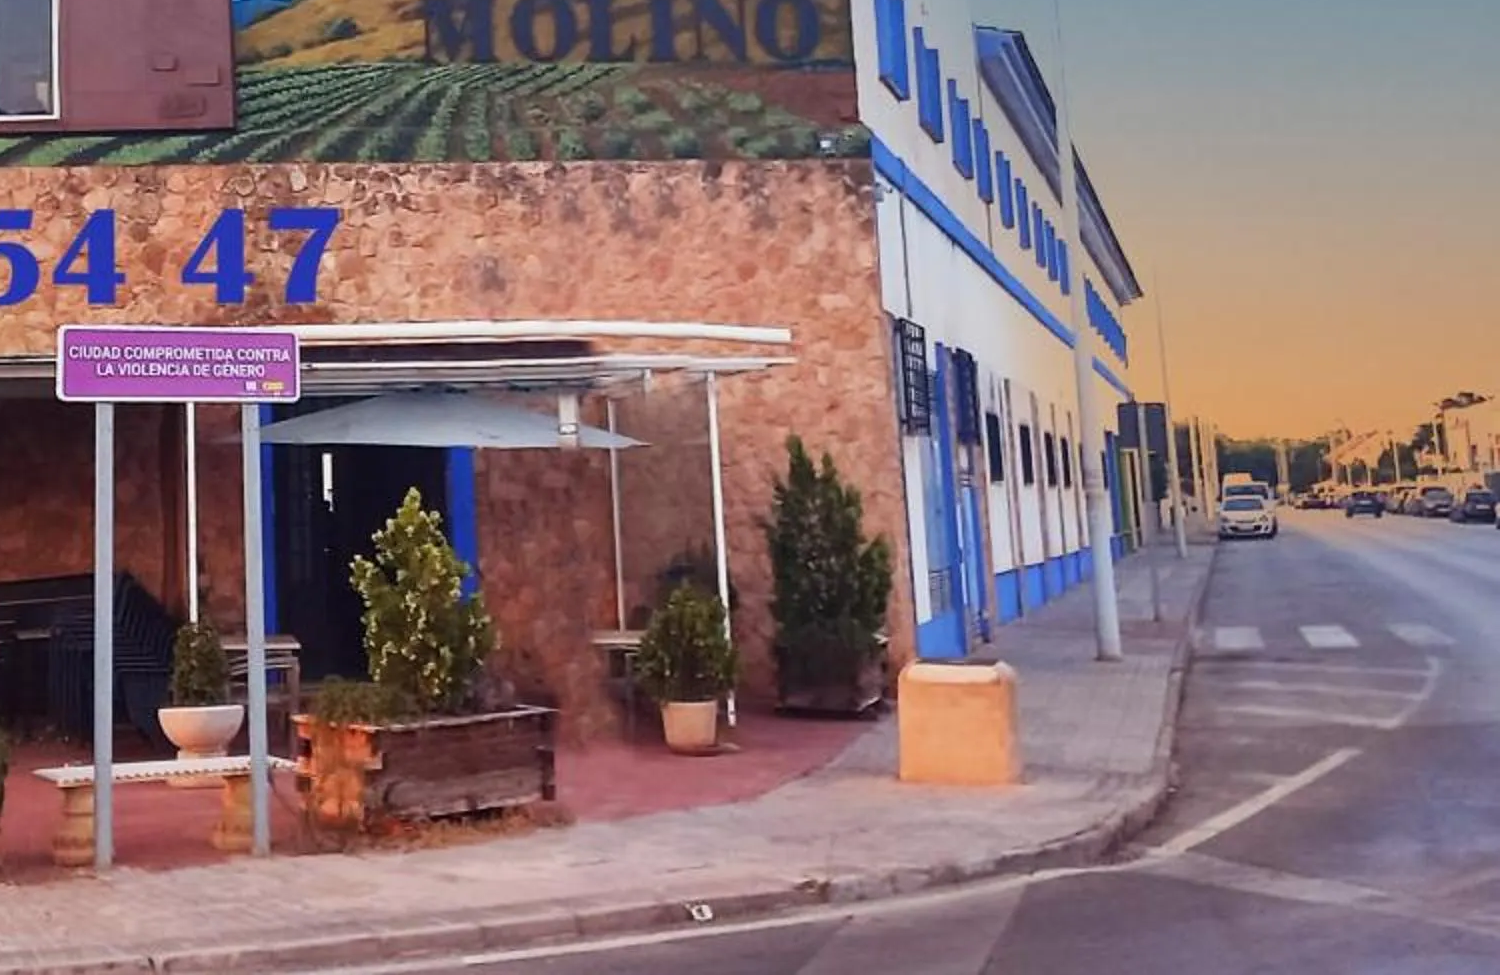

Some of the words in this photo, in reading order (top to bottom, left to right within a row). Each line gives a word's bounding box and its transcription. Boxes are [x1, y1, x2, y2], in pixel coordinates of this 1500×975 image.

[181, 208, 342, 304] 47
[69, 345, 121, 360] CIUDAD
[123, 346, 233, 362] COMPROMETIDA
[236, 349, 291, 363] CONTRA
[97, 362, 116, 376] LA
[119, 362, 190, 377] VIOLENCIA
[193, 363, 211, 377] DE
[213, 361, 265, 378] GÉNERO
